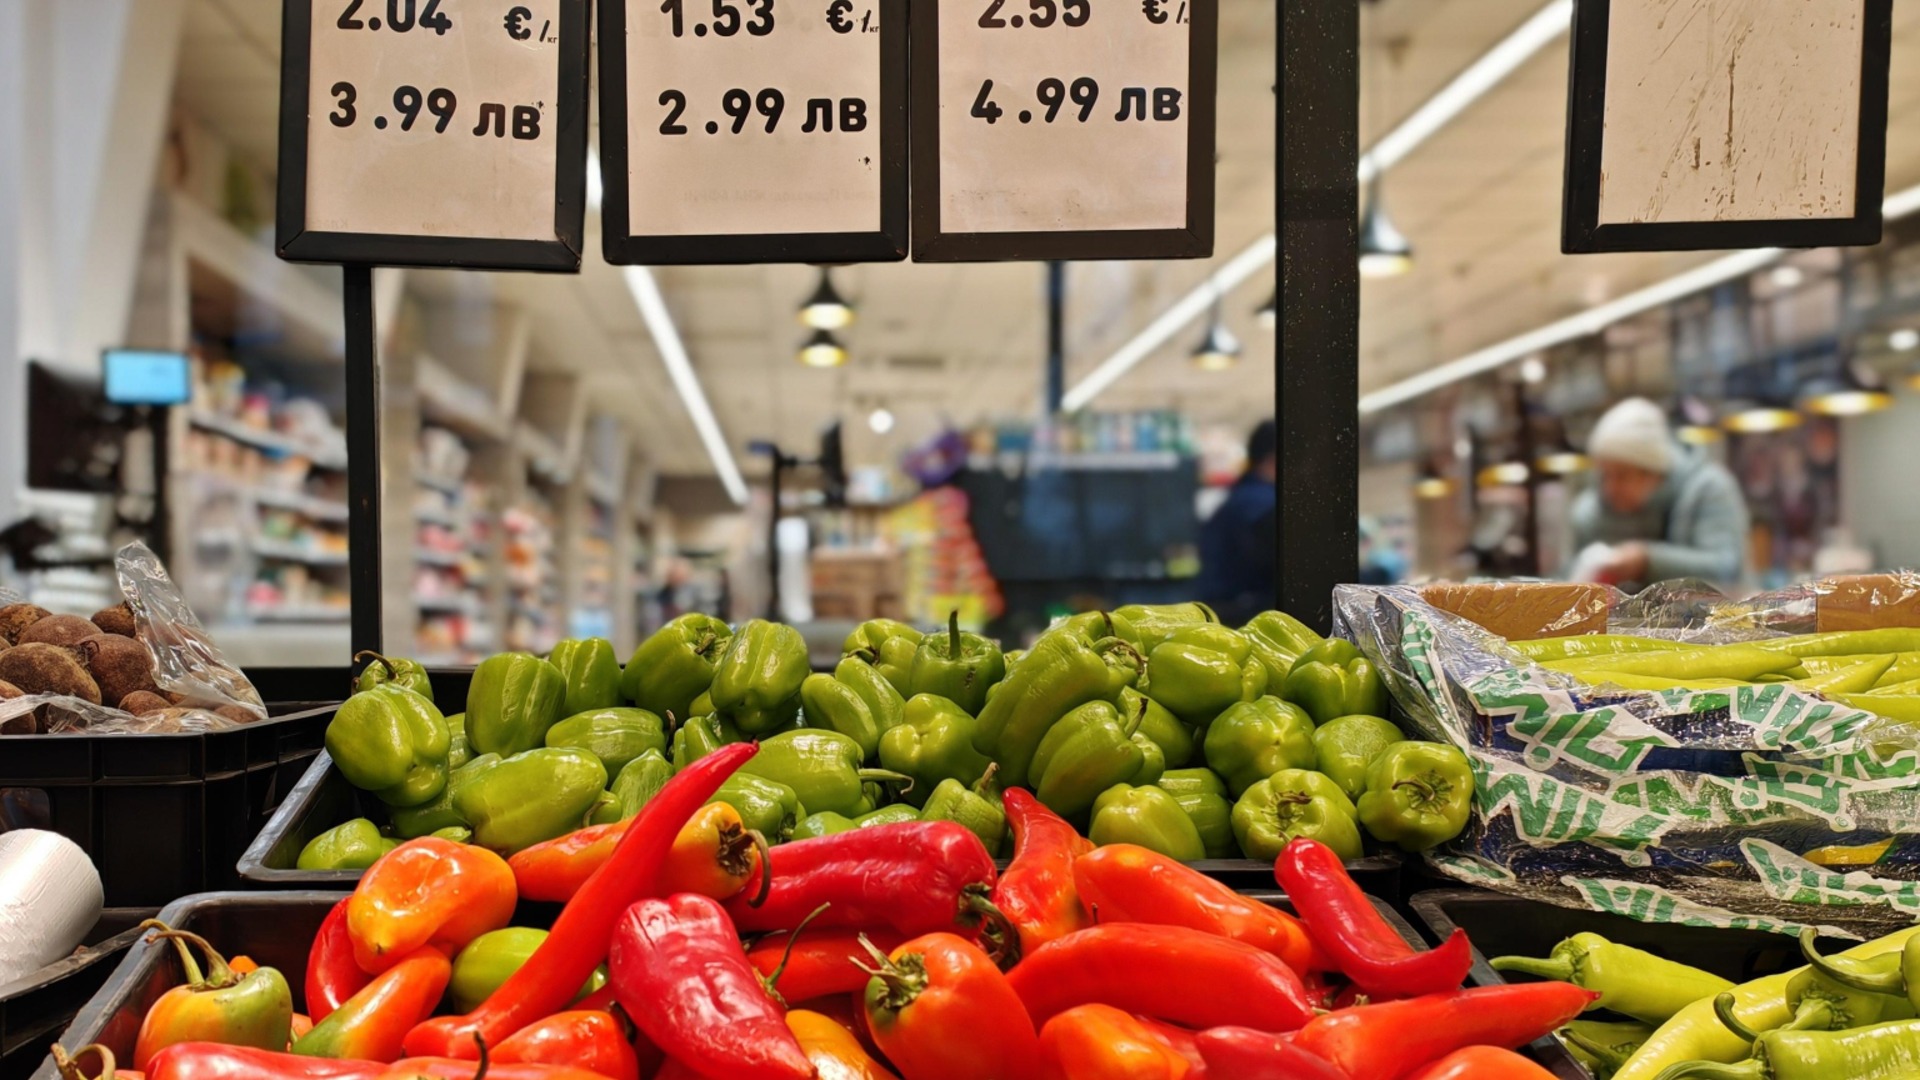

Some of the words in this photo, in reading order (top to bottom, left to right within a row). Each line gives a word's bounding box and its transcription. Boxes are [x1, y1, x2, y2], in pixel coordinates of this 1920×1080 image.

[660, 0, 775, 38] 1.53
[472, 102, 542, 141] лв
[800, 97, 869, 134] лв
[1114, 87, 1184, 122] лв
